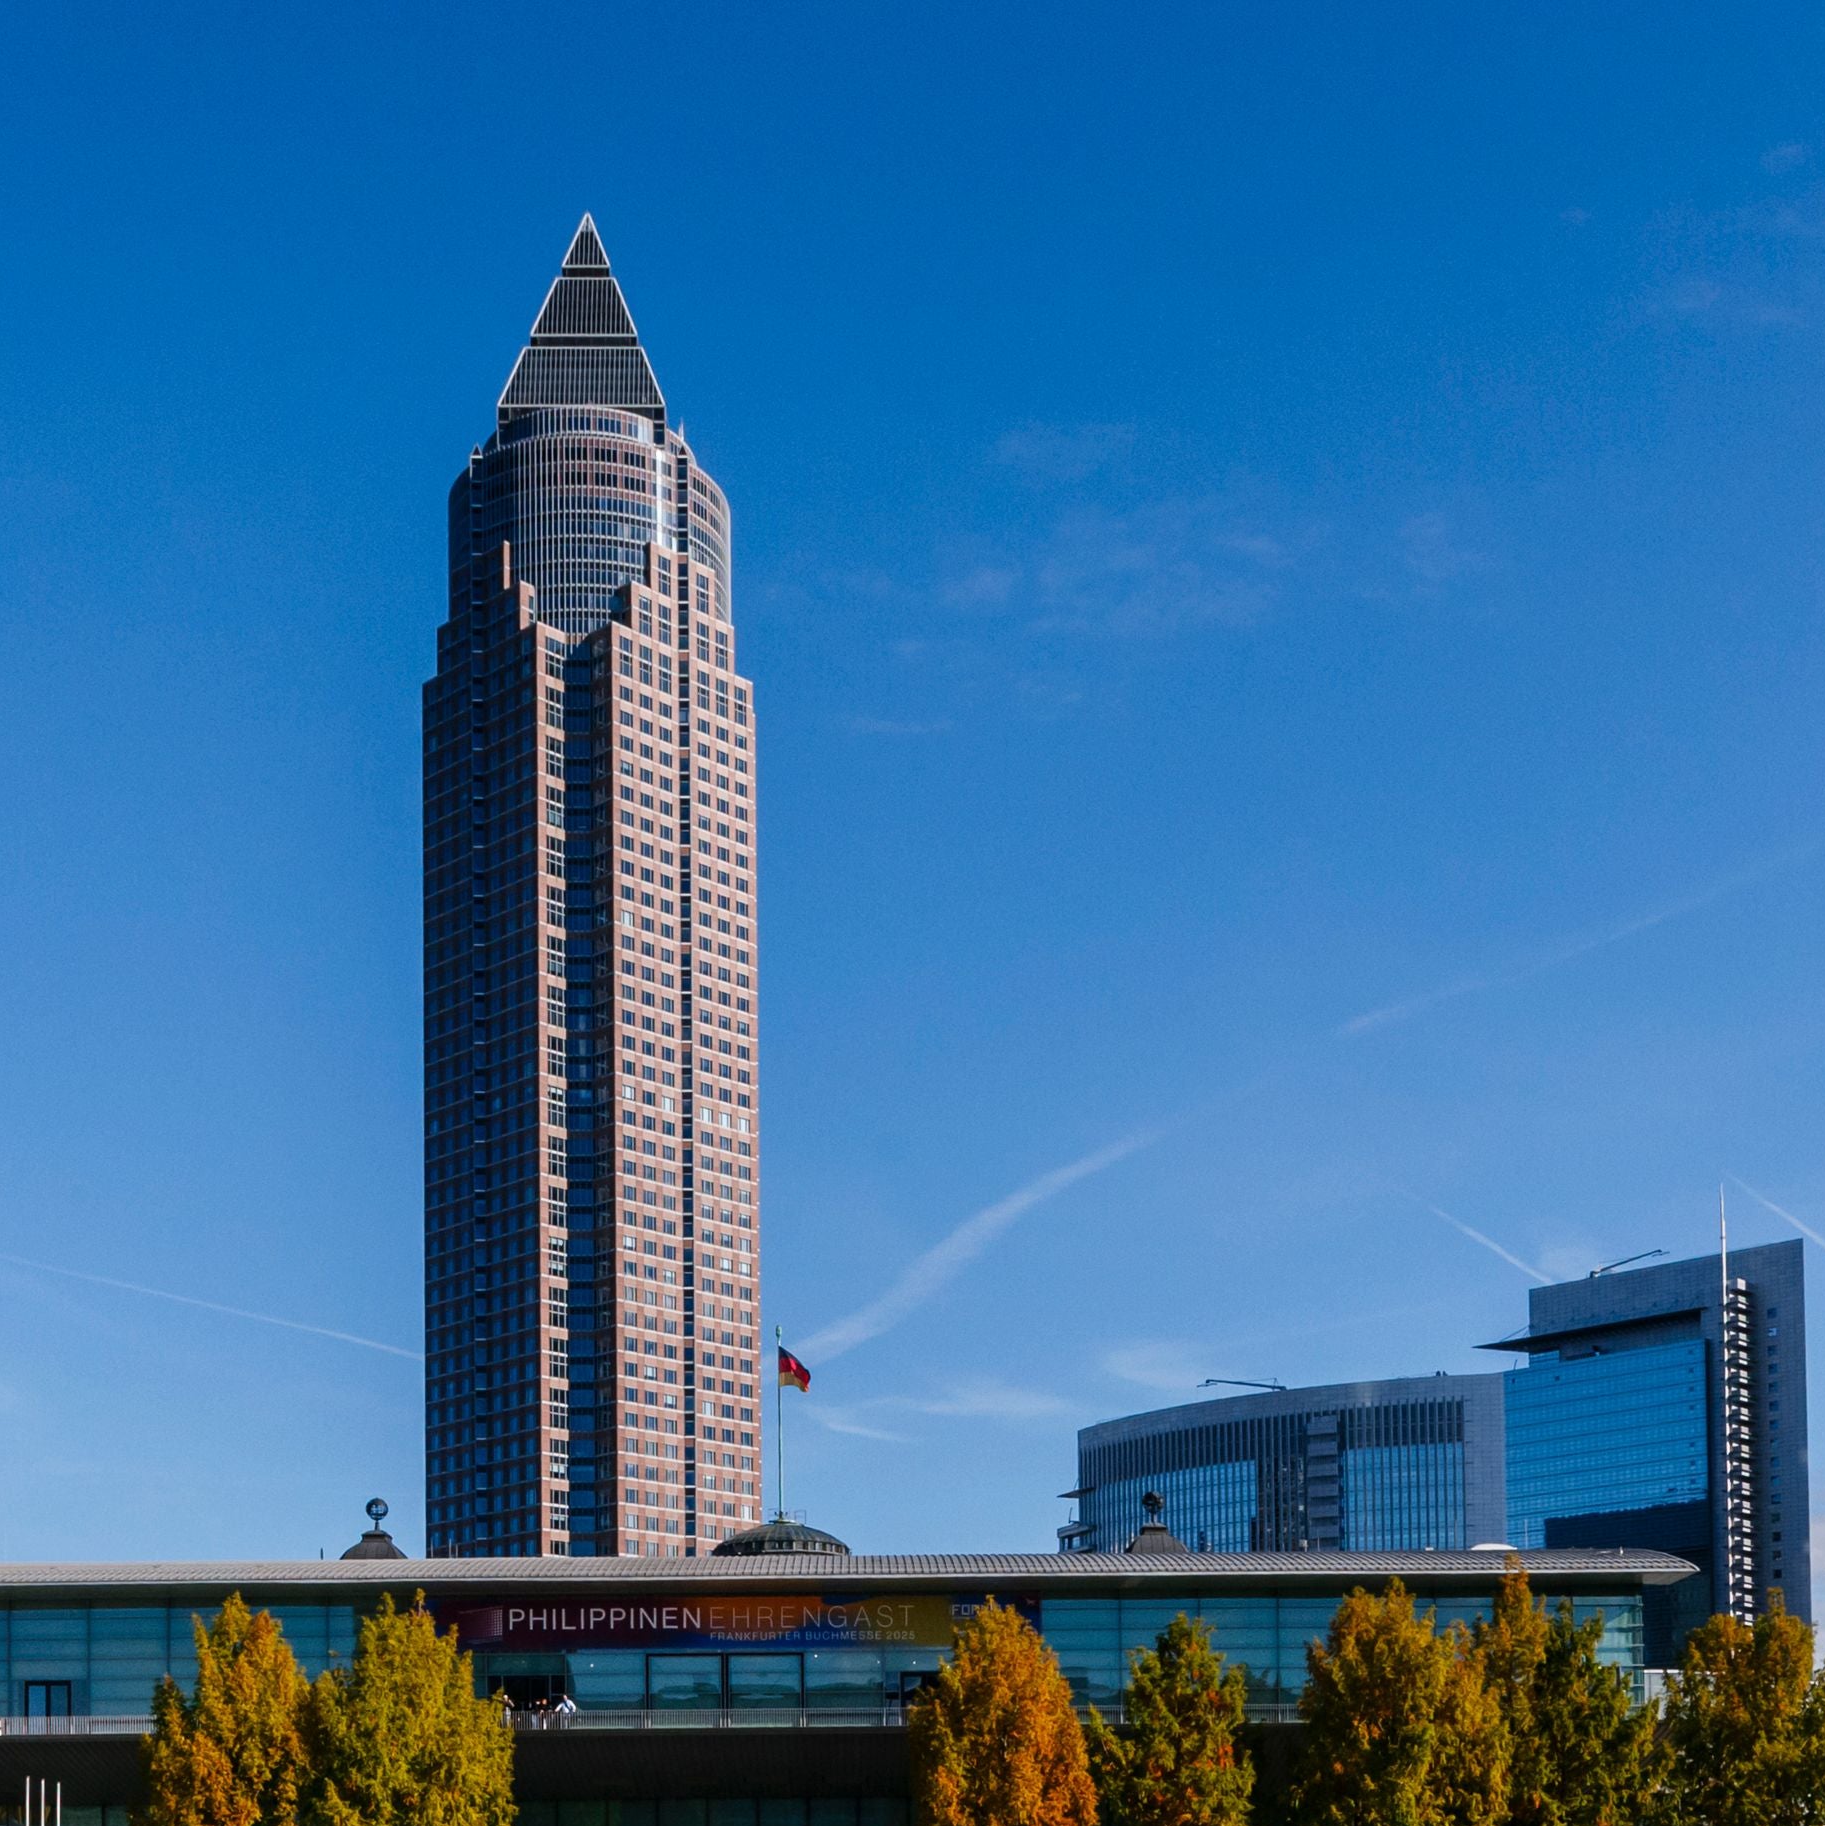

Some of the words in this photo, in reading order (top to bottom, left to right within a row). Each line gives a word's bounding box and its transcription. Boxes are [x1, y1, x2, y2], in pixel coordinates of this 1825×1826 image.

[509, 1607, 701, 1630] PHILIPPINEN
[709, 1605, 915, 1629] EHRENGAST
[710, 1631, 801, 1641] FRANKFURTER
[805, 1630, 882, 1640] BUCHMESSE
[886, 1630, 916, 1640] 2025
